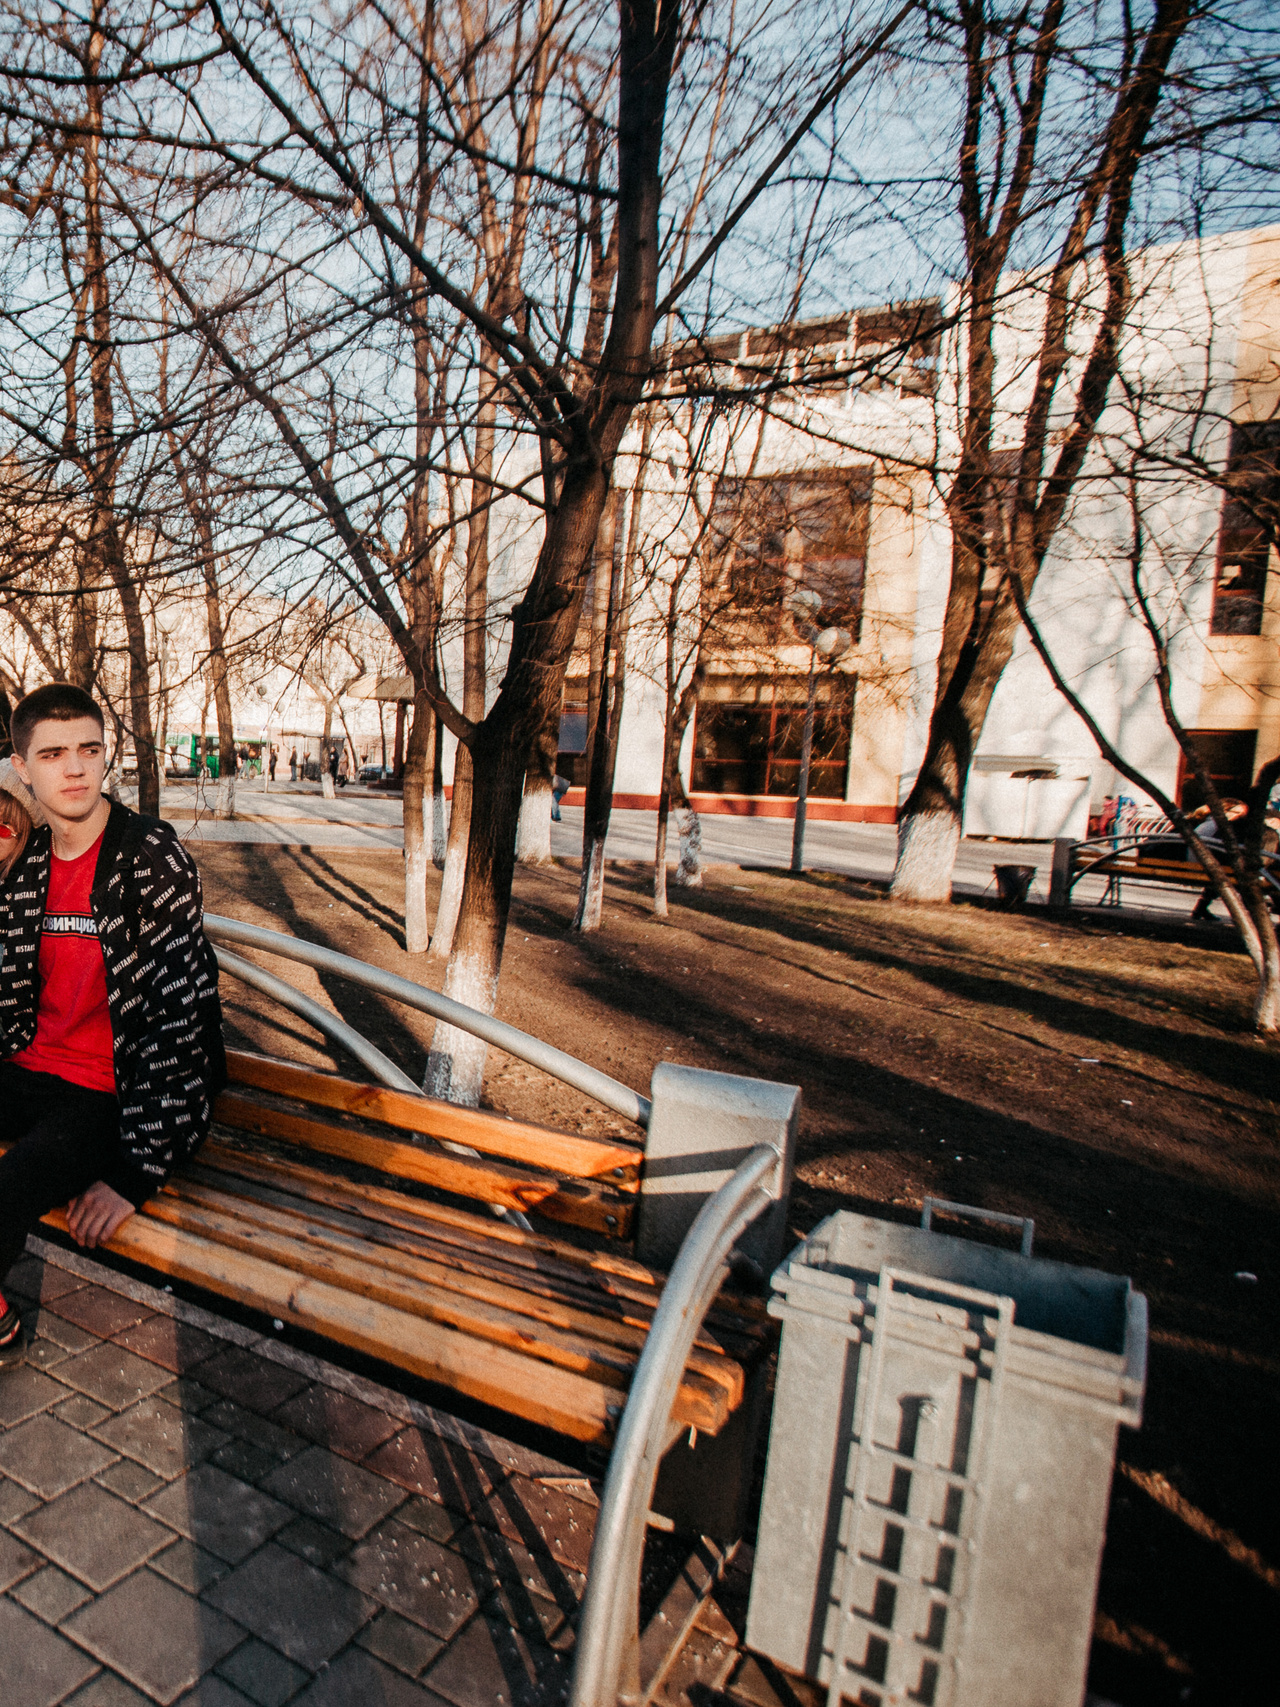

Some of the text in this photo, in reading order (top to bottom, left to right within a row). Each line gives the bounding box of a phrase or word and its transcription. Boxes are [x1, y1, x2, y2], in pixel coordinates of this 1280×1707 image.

[135, 959, 155, 980] MISTAKE
[162, 976, 187, 995] MISTAKE
[150, 1057, 178, 1070] MISTAKE
